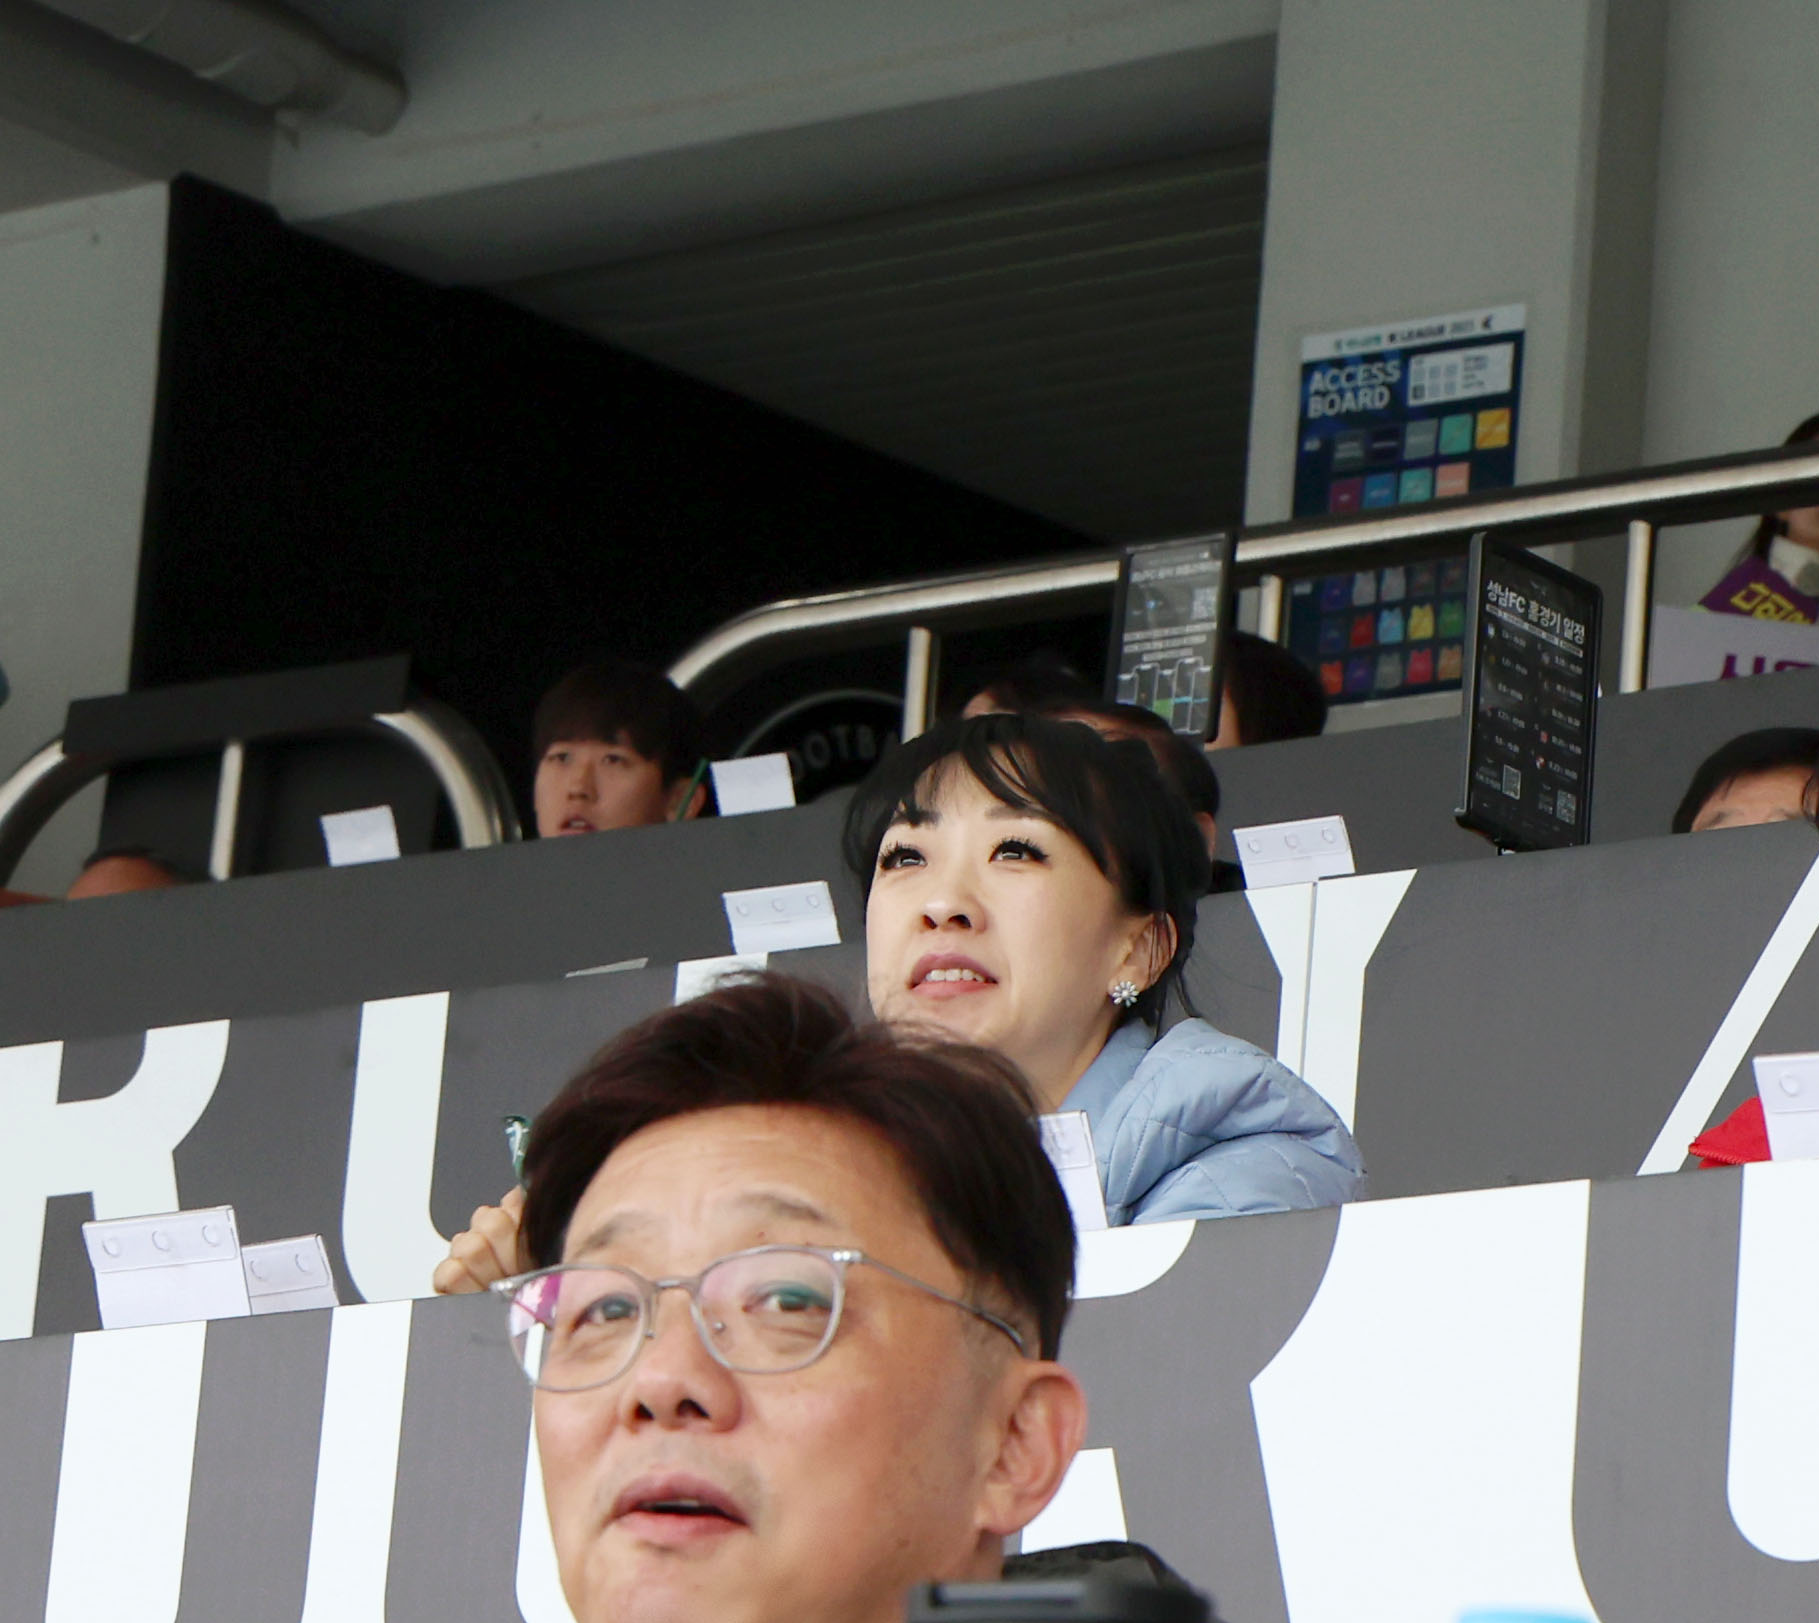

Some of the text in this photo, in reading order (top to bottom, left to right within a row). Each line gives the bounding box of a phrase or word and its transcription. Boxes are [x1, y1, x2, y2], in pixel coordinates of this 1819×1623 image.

[1309, 360, 1402, 393] ACCESS
[1307, 387, 1391, 419] BOARD
[1488, 581, 1525, 613] 성남FC
[1564, 616, 1585, 644] 일정
